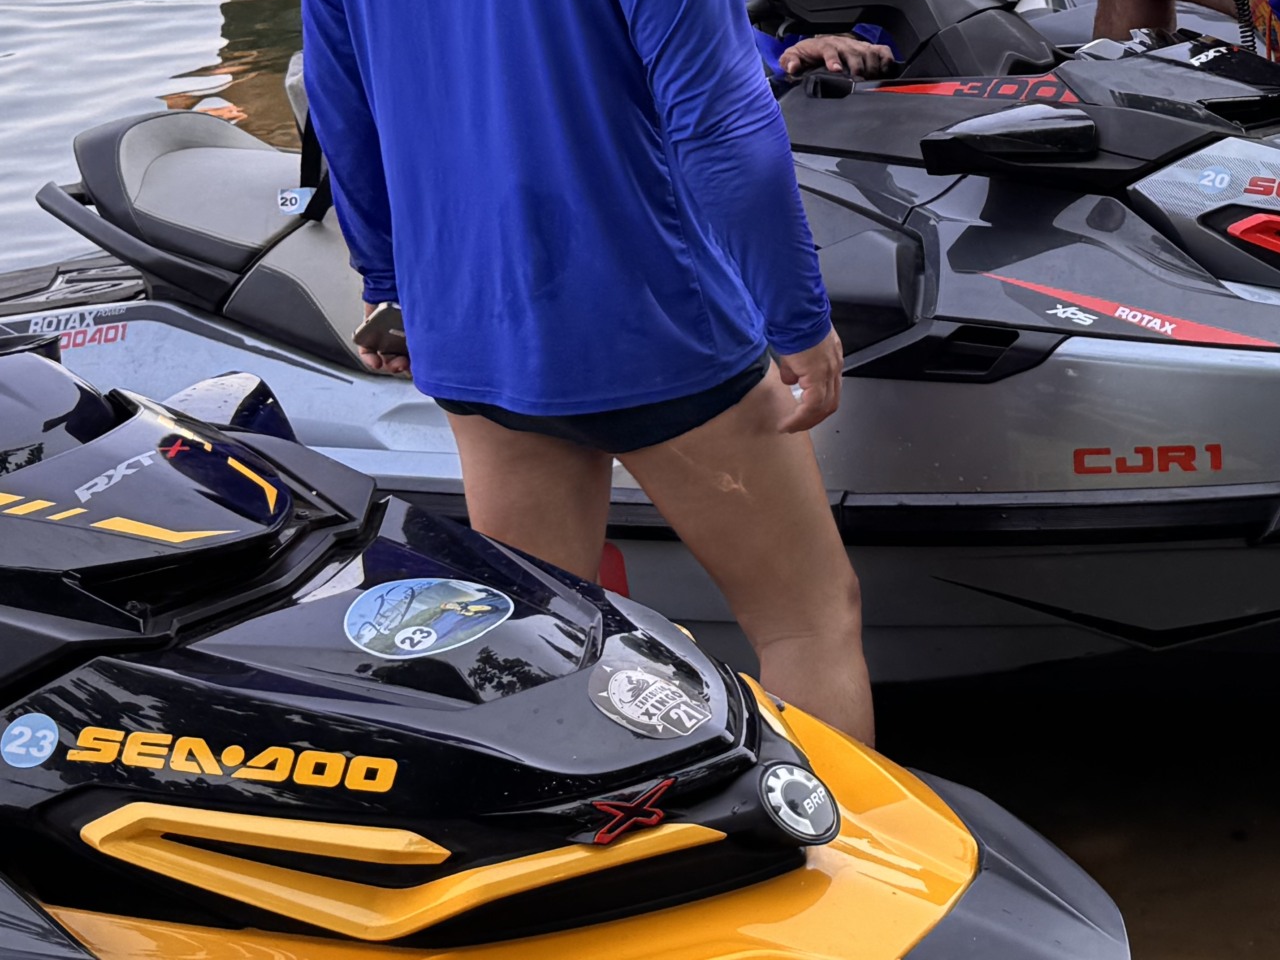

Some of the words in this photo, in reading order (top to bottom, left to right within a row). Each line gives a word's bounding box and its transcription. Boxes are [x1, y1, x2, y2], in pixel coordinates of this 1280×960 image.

[1189, 46, 1229, 67] RXT
[1201, 170, 1231, 188] 20
[280, 196, 299, 207] 20
[28, 310, 98, 334] ROTAX
[1045, 304, 1099, 325] XPS
[1114, 306, 1177, 335] ROTAX
[1073, 443, 1222, 474] CJR1
[74, 450, 157, 503] RXT
[400, 628, 432, 649] 23
[669, 704, 704, 728] 21
[5, 725, 55, 757] 23
[803, 787, 826, 814] BRP
